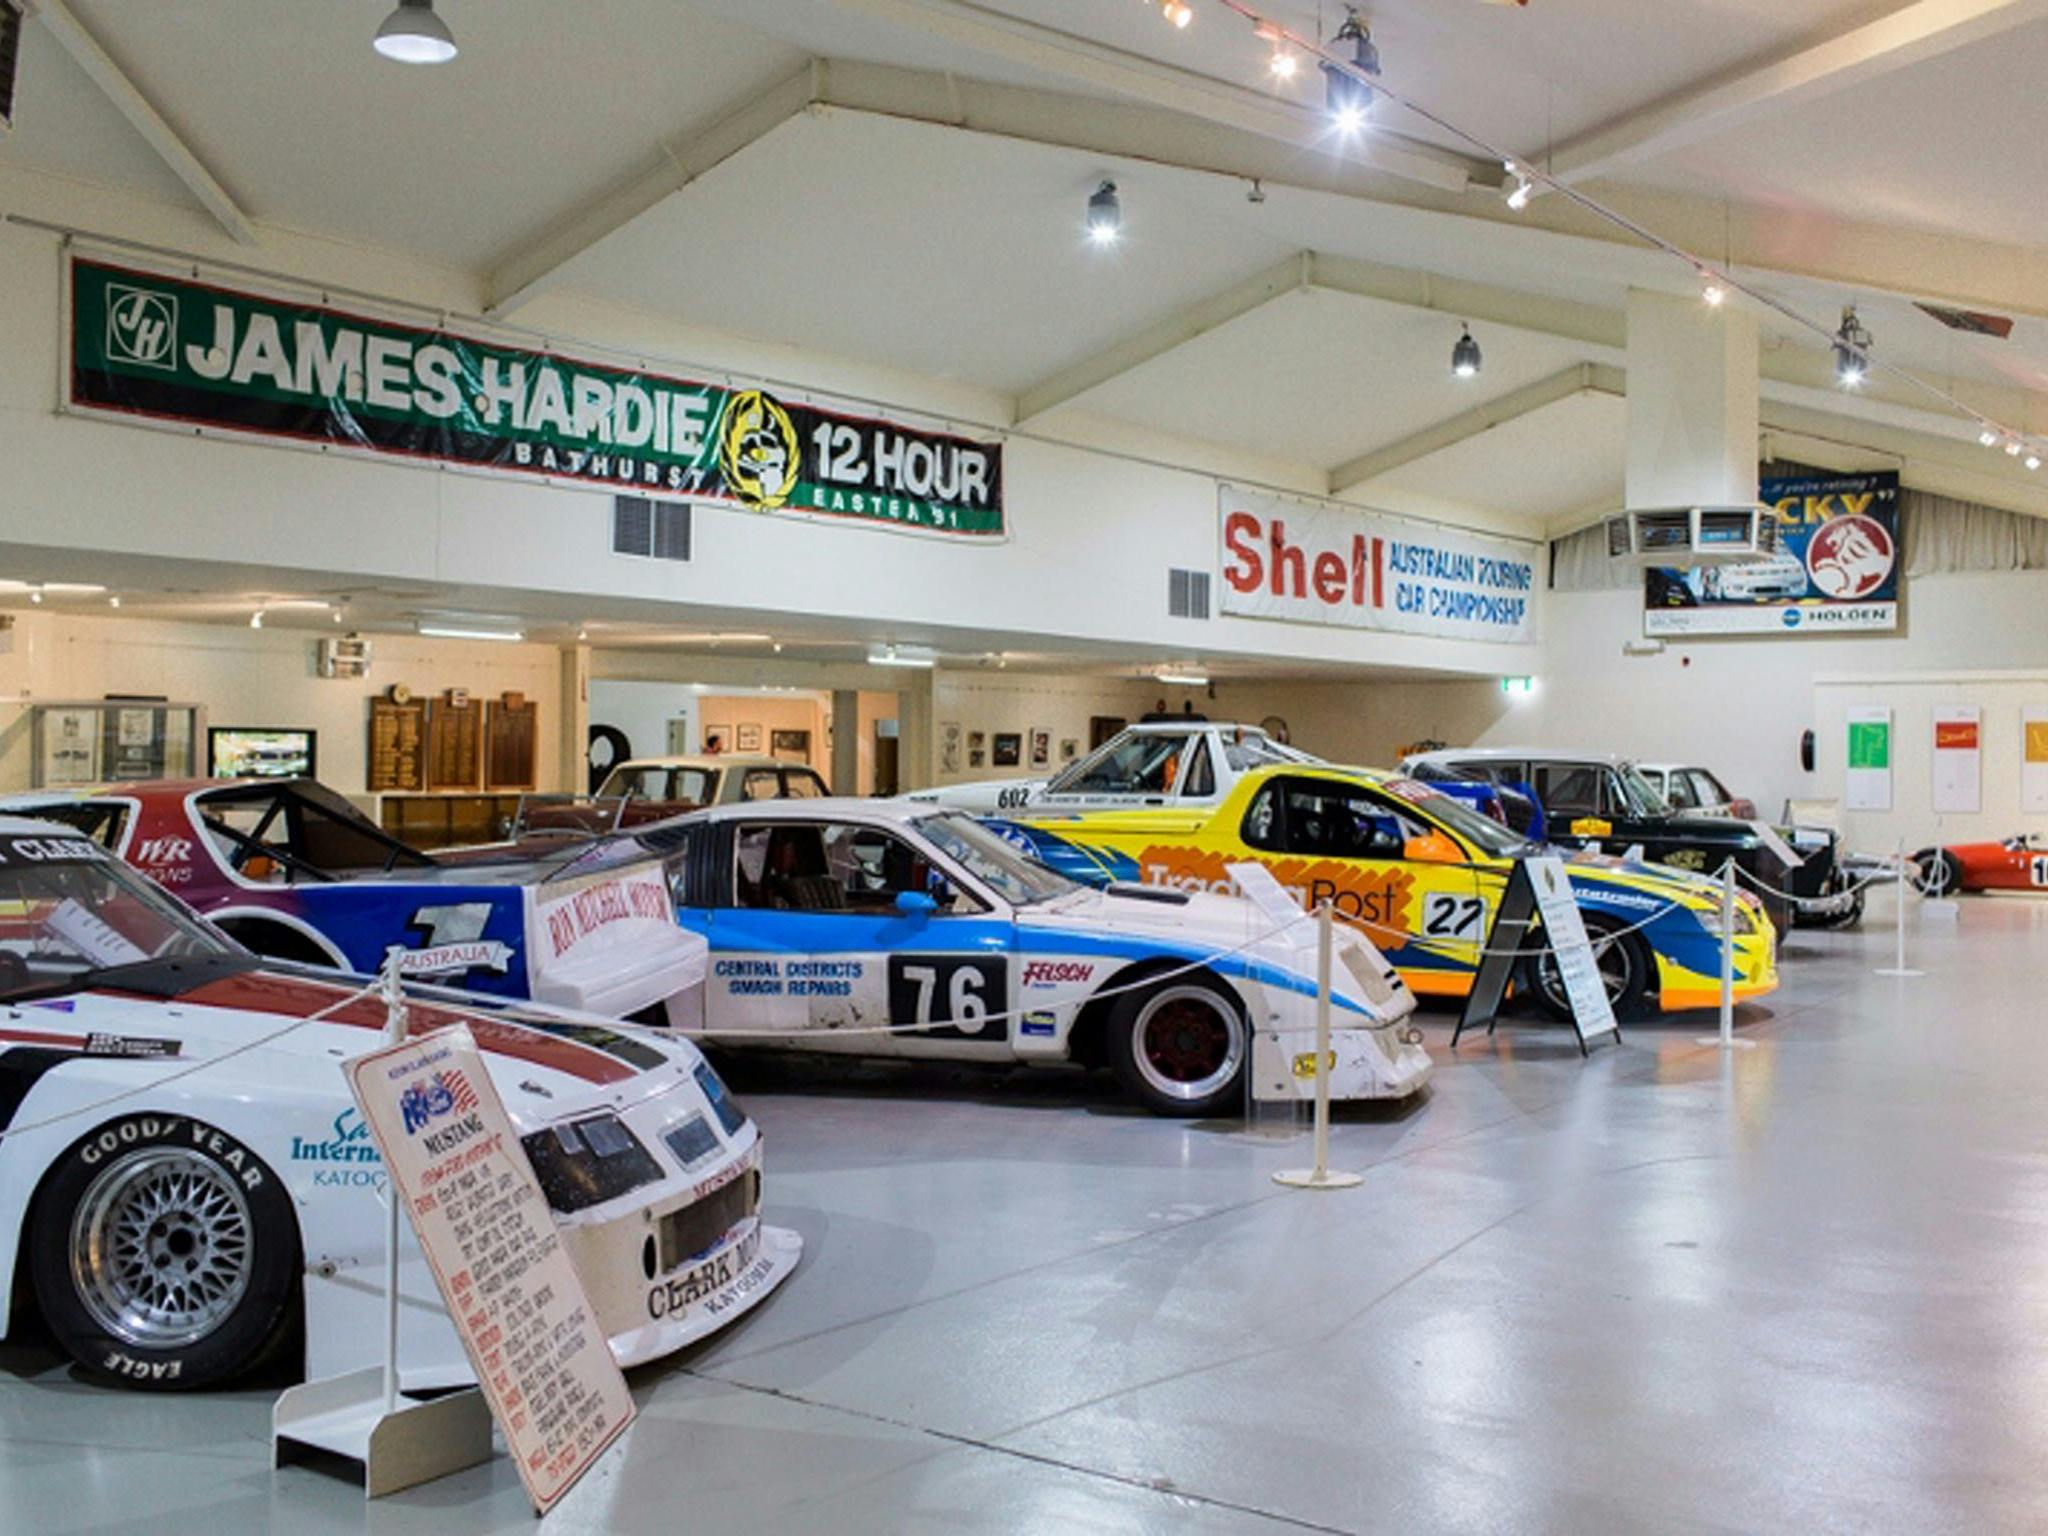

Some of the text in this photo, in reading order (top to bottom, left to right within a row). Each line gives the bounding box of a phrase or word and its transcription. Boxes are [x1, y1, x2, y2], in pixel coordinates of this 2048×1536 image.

[185, 305, 709, 457] JAMES HARDIE
[514, 442, 706, 493] BATHURST
[812, 421, 989, 505] 12 HOUR
[1223, 511, 1385, 609] Shell
[1389, 540, 1532, 591] AUSTRALIAN TOURING
[1396, 581, 1526, 625] CAR CHAMPIONSHIP
[1808, 607, 1887, 622] HOLDEN
[997, 787, 1030, 809] 602
[1311, 879, 1396, 923] Post
[1426, 897, 1483, 935] 27
[401, 944, 491, 968] AUSTRALIA
[715, 959, 864, 979] CENTRAL DISTRICTS
[729, 979, 853, 997] SMASH REPAIRS
[903, 965, 987, 1035] 76
[423, 1112, 484, 1158] MUSTANG
[647, 1252, 731, 1321] CLARK
[104, 1351, 183, 1381] EAGLE
